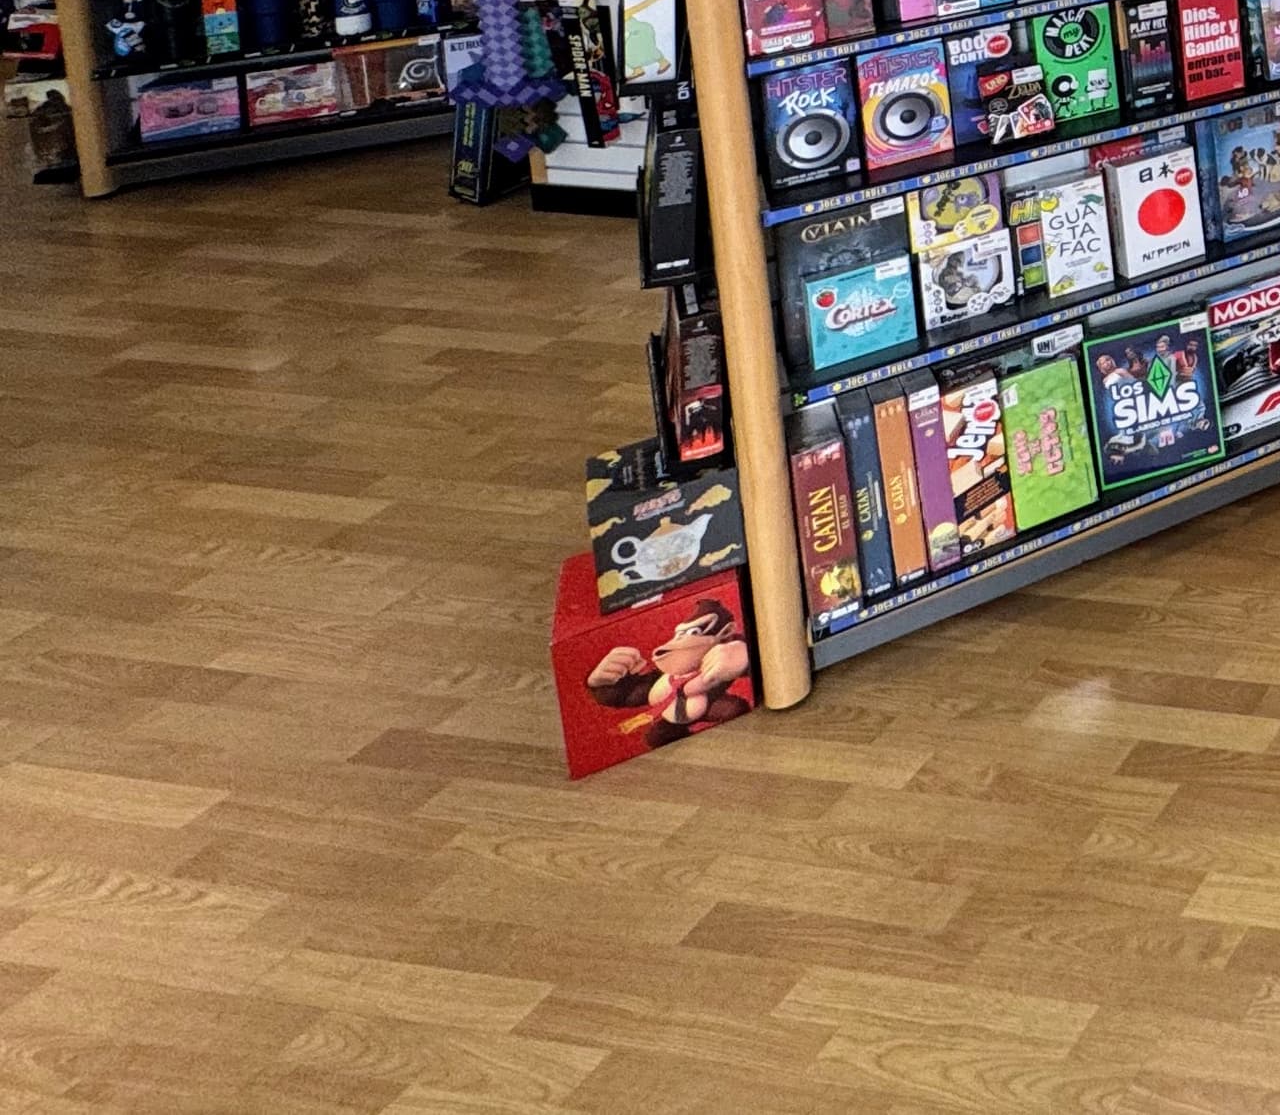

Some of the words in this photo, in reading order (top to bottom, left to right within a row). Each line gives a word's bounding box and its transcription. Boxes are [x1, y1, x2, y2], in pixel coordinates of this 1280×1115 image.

[1045, 8, 1086, 37] MATCH
[1130, 18, 1150, 33] PLAY
[1183, 19, 1227, 42] Hitler
[1229, 18, 1239, 34] y
[1065, 35, 1095, 58] BEAT
[1185, 34, 1240, 59] Gandhi
[569, 34, 592, 97] SPIDER-MAN
[862, 48, 940, 79] HITSTER
[1187, 54, 1226, 71] entran
[1227, 52, 1241, 62] en
[767, 68, 848, 99] HITSTER
[867, 68, 940, 99] TEMAZOS
[1188, 70, 1203, 82] un
[778, 86, 838, 118] ROCK
[1139, 161, 1175, 183] 日本
[1050, 204, 1097, 230] GUA
[1067, 222, 1096, 238] TA
[1059, 238, 1101, 258] FAC
[1142, 239, 1191, 263] NIPPON
[829, 295, 895, 327] CORTEX
[1111, 382, 1143, 401] LOS
[1113, 383, 1200, 431] SIMS
[855, 487, 871, 524] CATAN
[890, 474, 906, 511] CATAN
[808, 485, 838, 554] CATAN
